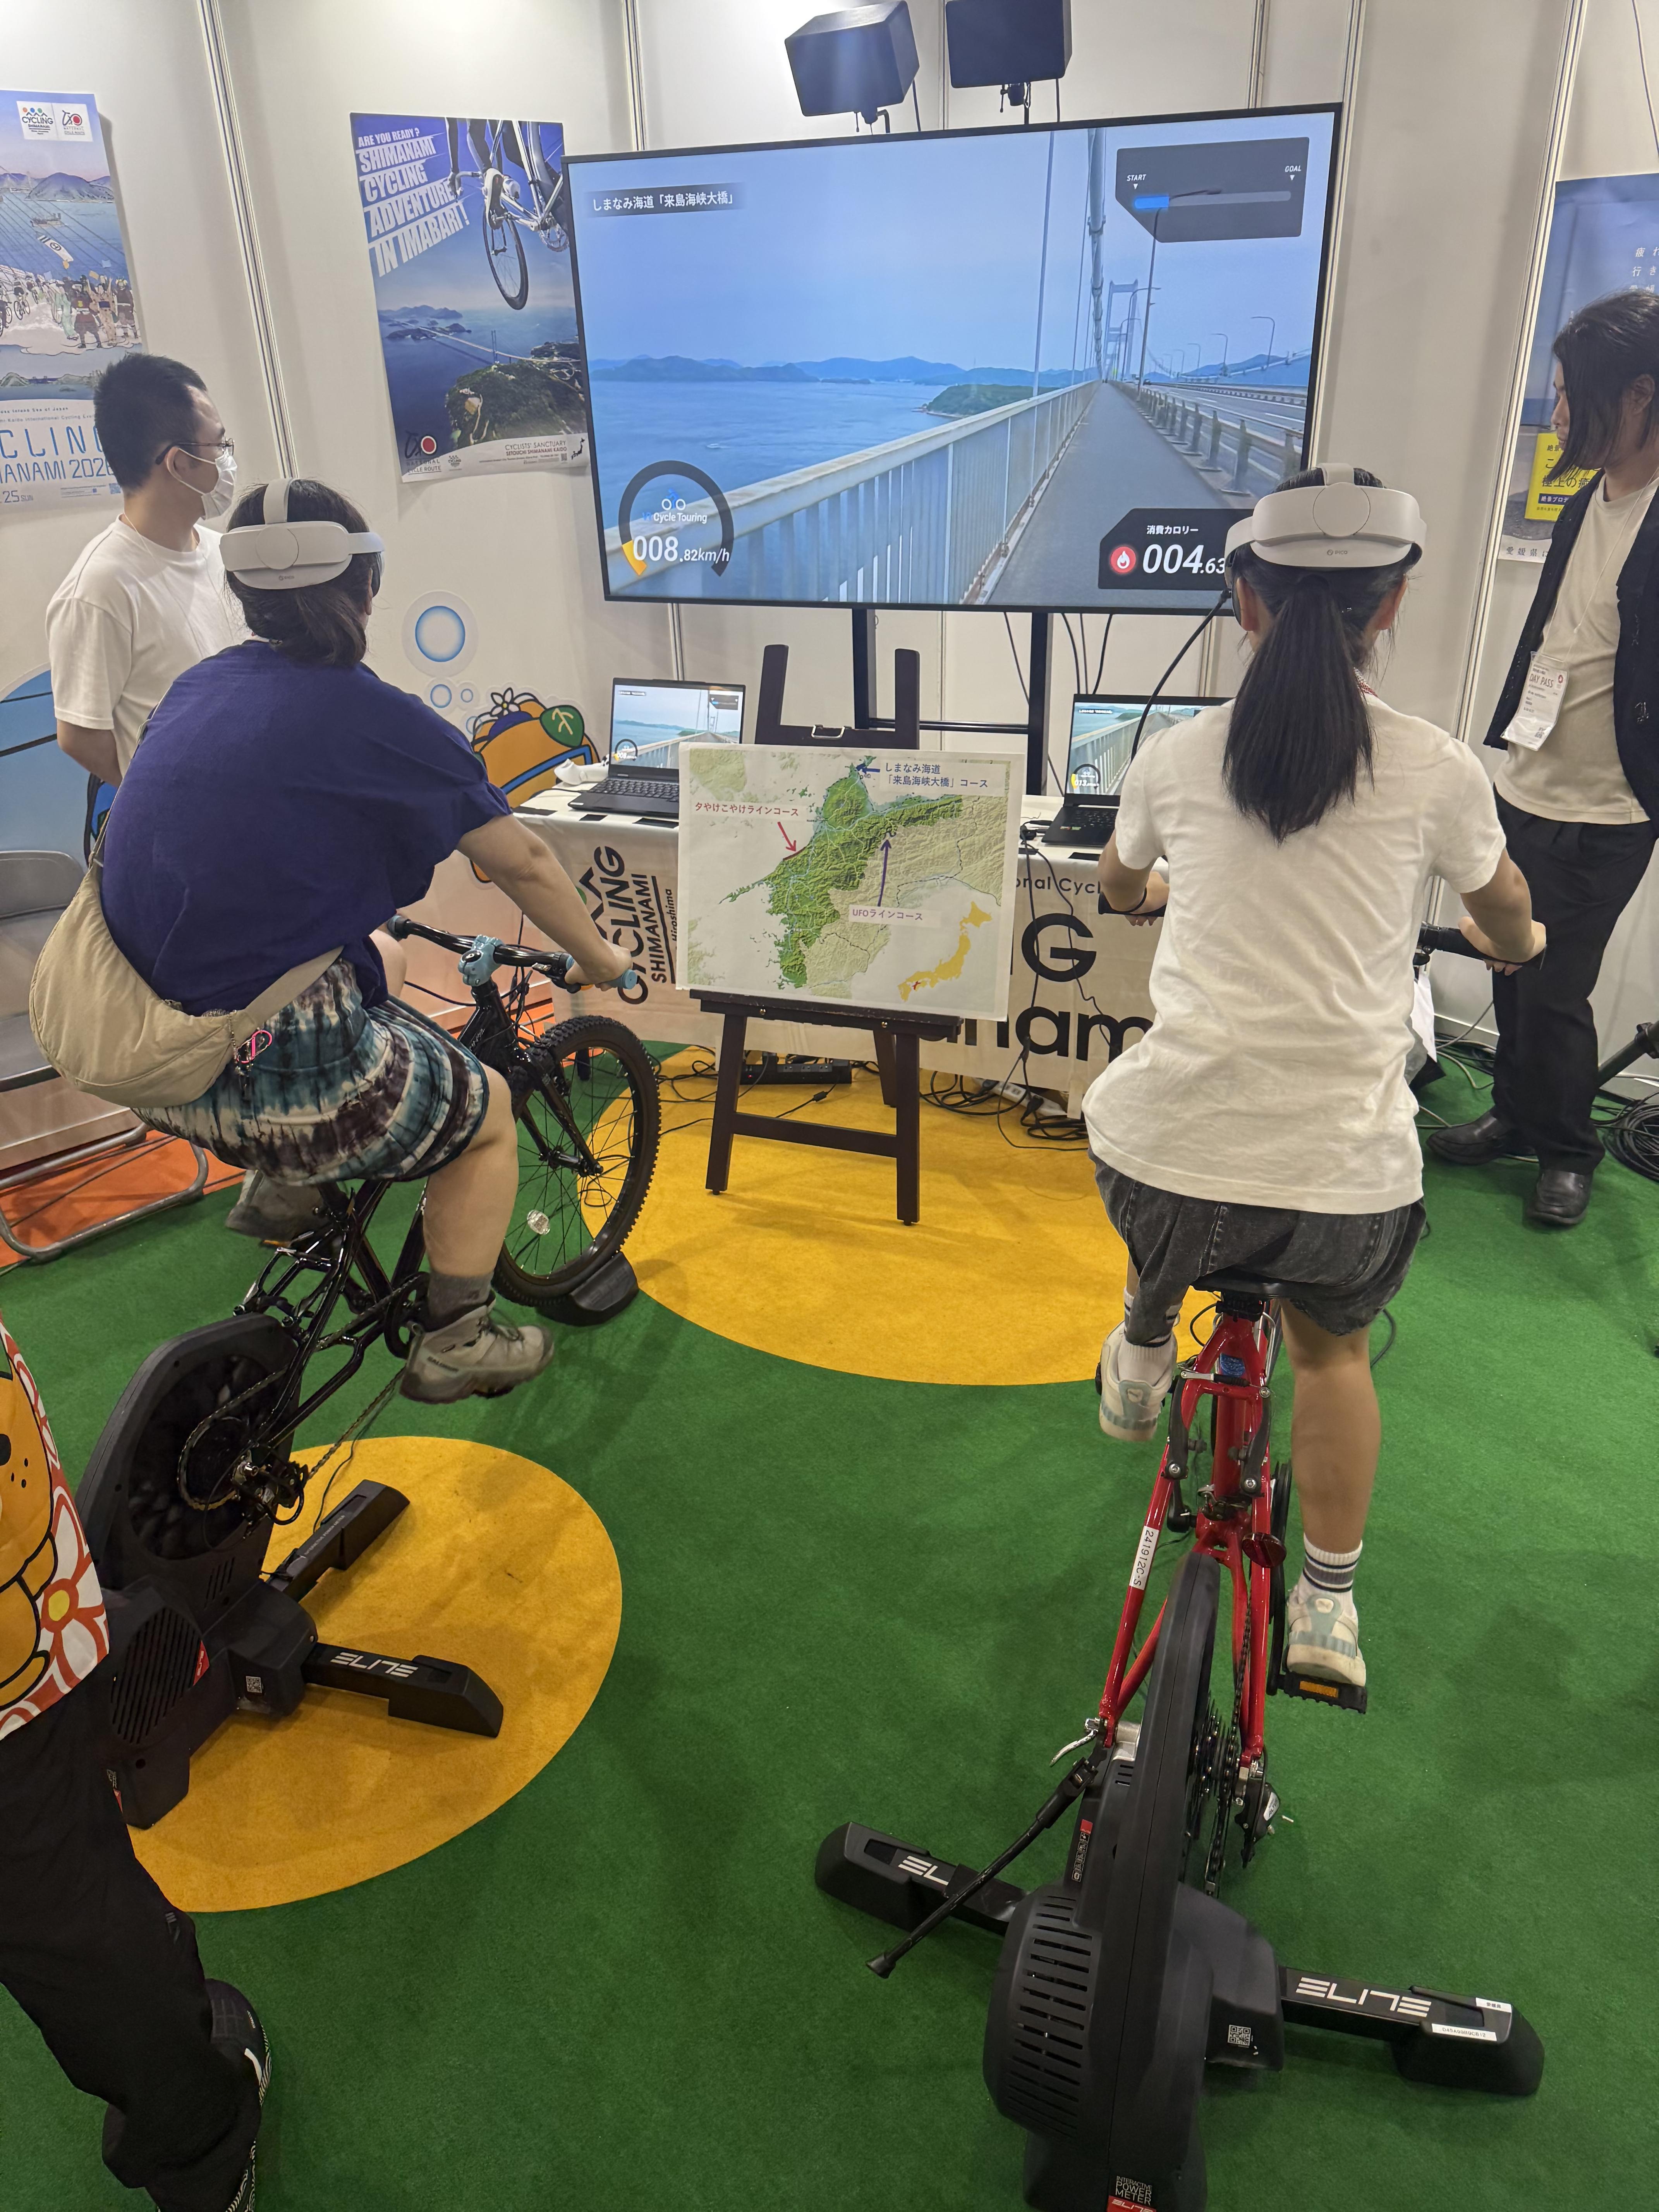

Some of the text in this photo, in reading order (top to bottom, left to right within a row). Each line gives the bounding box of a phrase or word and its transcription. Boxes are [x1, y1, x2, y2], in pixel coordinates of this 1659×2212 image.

[22, 116, 53, 124] CYCLING
[359, 135, 375, 148] ARE
[375, 132, 391, 143] YOU
[393, 128, 414, 141] READY
[356, 136, 436, 173] SHIMANAMI
[360, 159, 428, 202] CYCLING
[363, 177, 456, 238] ADVENTURE
[593, 191, 733, 211] しまなみ海道「来島海峡大橋」
[368, 232, 398, 277] IN
[393, 202, 464, 263] IMABARI
[534, 440, 566, 448] SANCTUARY
[0, 460, 66, 483] ANAMI
[3, 490, 20, 503] 25
[653, 512, 676, 524] Cycle
[677, 512, 708, 524] Touring
[1146, 525, 1199, 535] 消費カロリー
[1529, 674, 1540, 683] DAY
[1540, 677, 1554, 688] PASS
[886, 763, 941, 775] しまなみ海道
[852, 908, 923, 921] UFOラインコース
[593, 846, 649, 1005] CCLING
[631, 873, 667, 984] SHIMANAMI
[1133, 1530, 1154, 1586] 241912C-S
[330, 1652, 419, 1678] ELITE
[1295, 1977, 1432, 2018] ELITE
[1116, 2176, 1152, 2191] INTERACTIVE
[1116, 2181, 1152, 2198] POWER
[1115, 2188, 1151, 2206] METER
